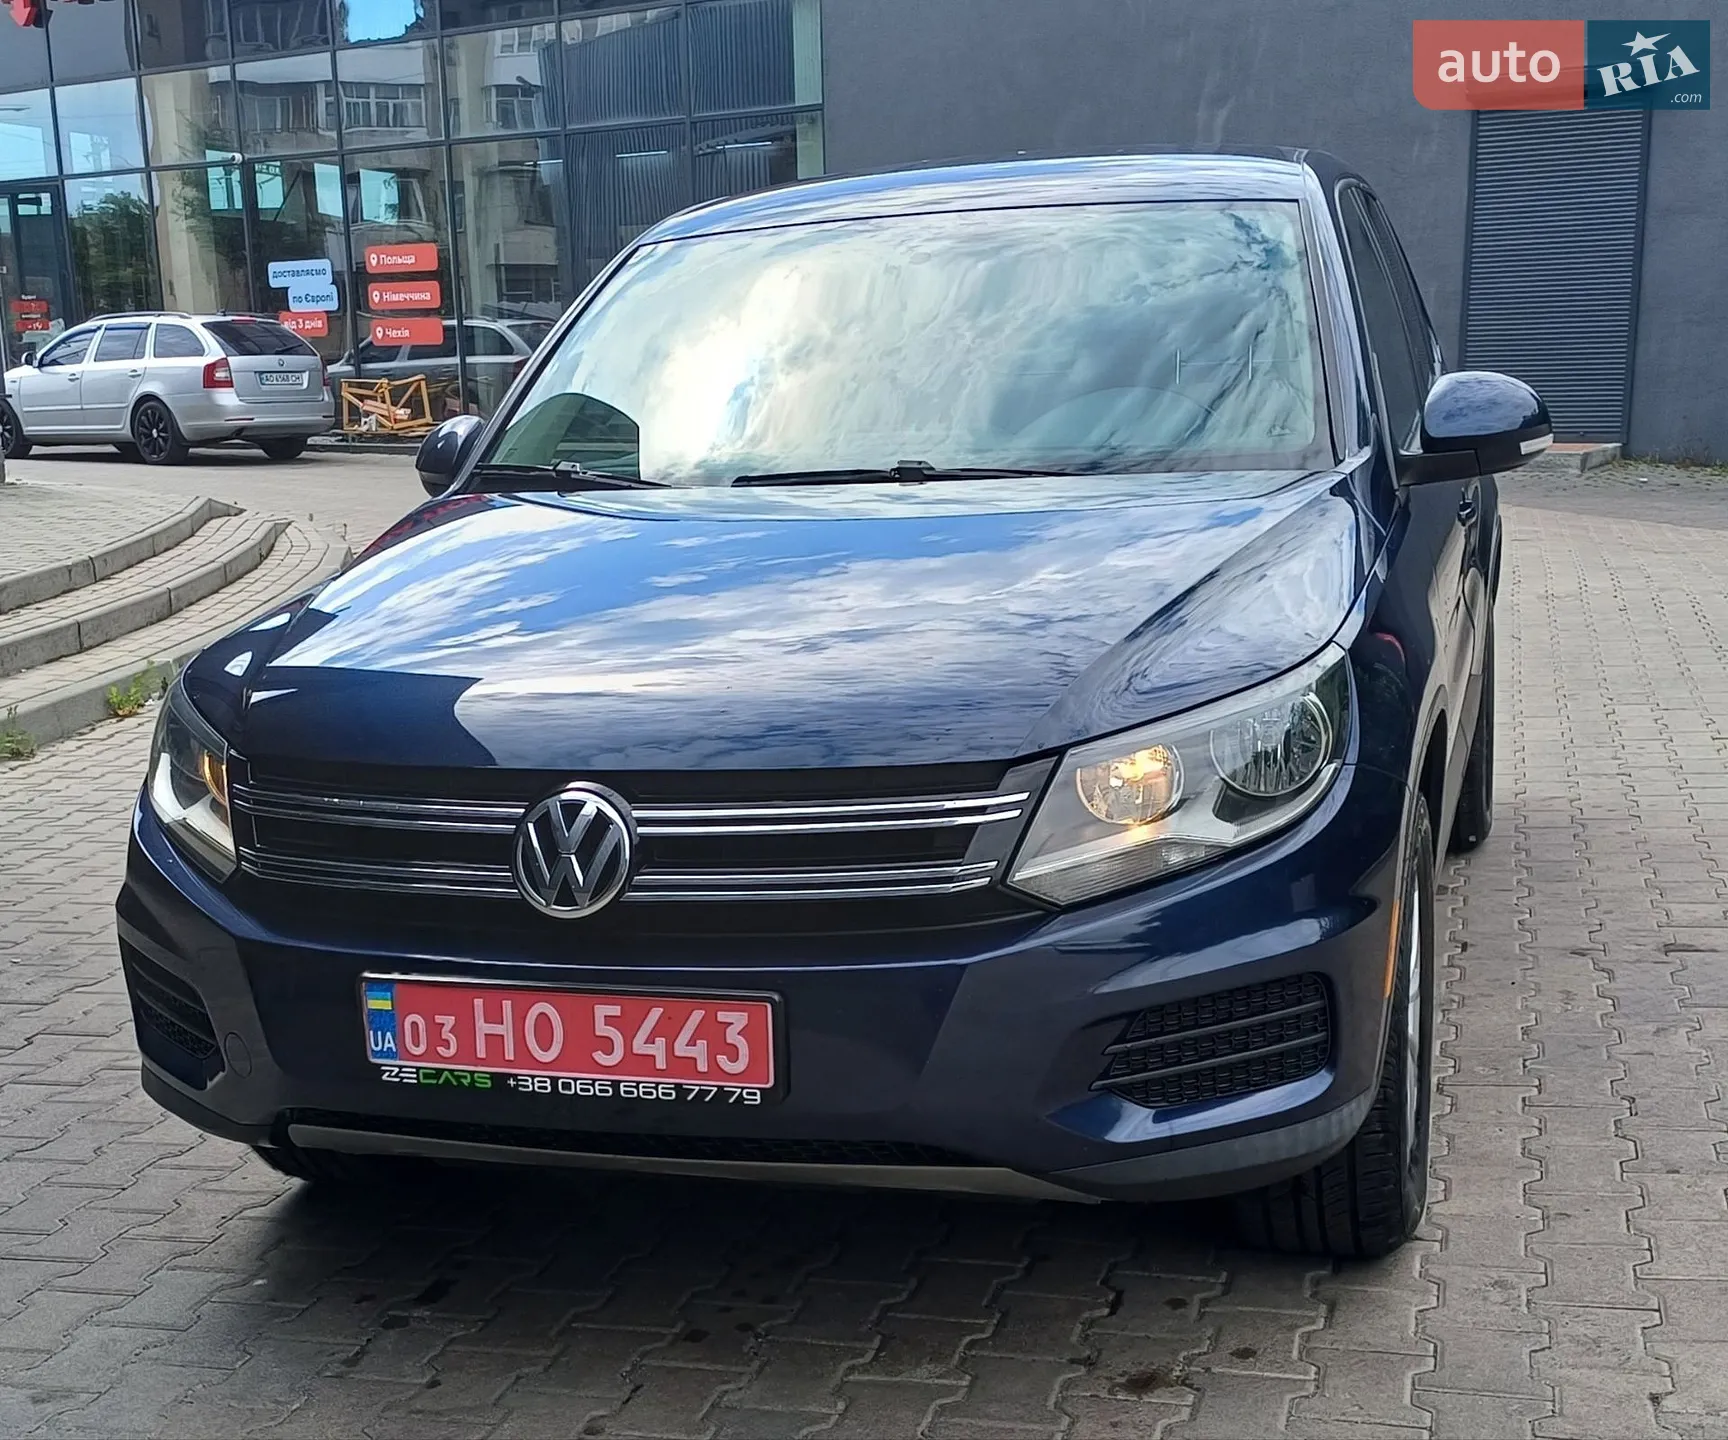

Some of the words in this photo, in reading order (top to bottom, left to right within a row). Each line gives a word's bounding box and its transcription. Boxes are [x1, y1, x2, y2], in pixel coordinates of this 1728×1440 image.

[379, 253, 416, 266] Польща
[272, 268, 327, 279] доставляємо
[292, 295, 303, 304] по
[304, 291, 334, 305] Європі
[382, 291, 431, 302] Німеччина
[297, 318, 304, 329] 3
[304, 318, 323, 330] днів
[386, 326, 410, 338] Чехія
[369, 1030, 396, 1053] UA
[403, 1013, 458, 1058] 03
[472, 998, 564, 1063] HO
[591, 1004, 751, 1076] 5443
[506, 1076, 551, 1094] +38
[558, 1079, 613, 1098] 066
[619, 1082, 677, 1101] 666
[685, 1085, 718, 1103] 77
[728, 1088, 762, 1106] 79
